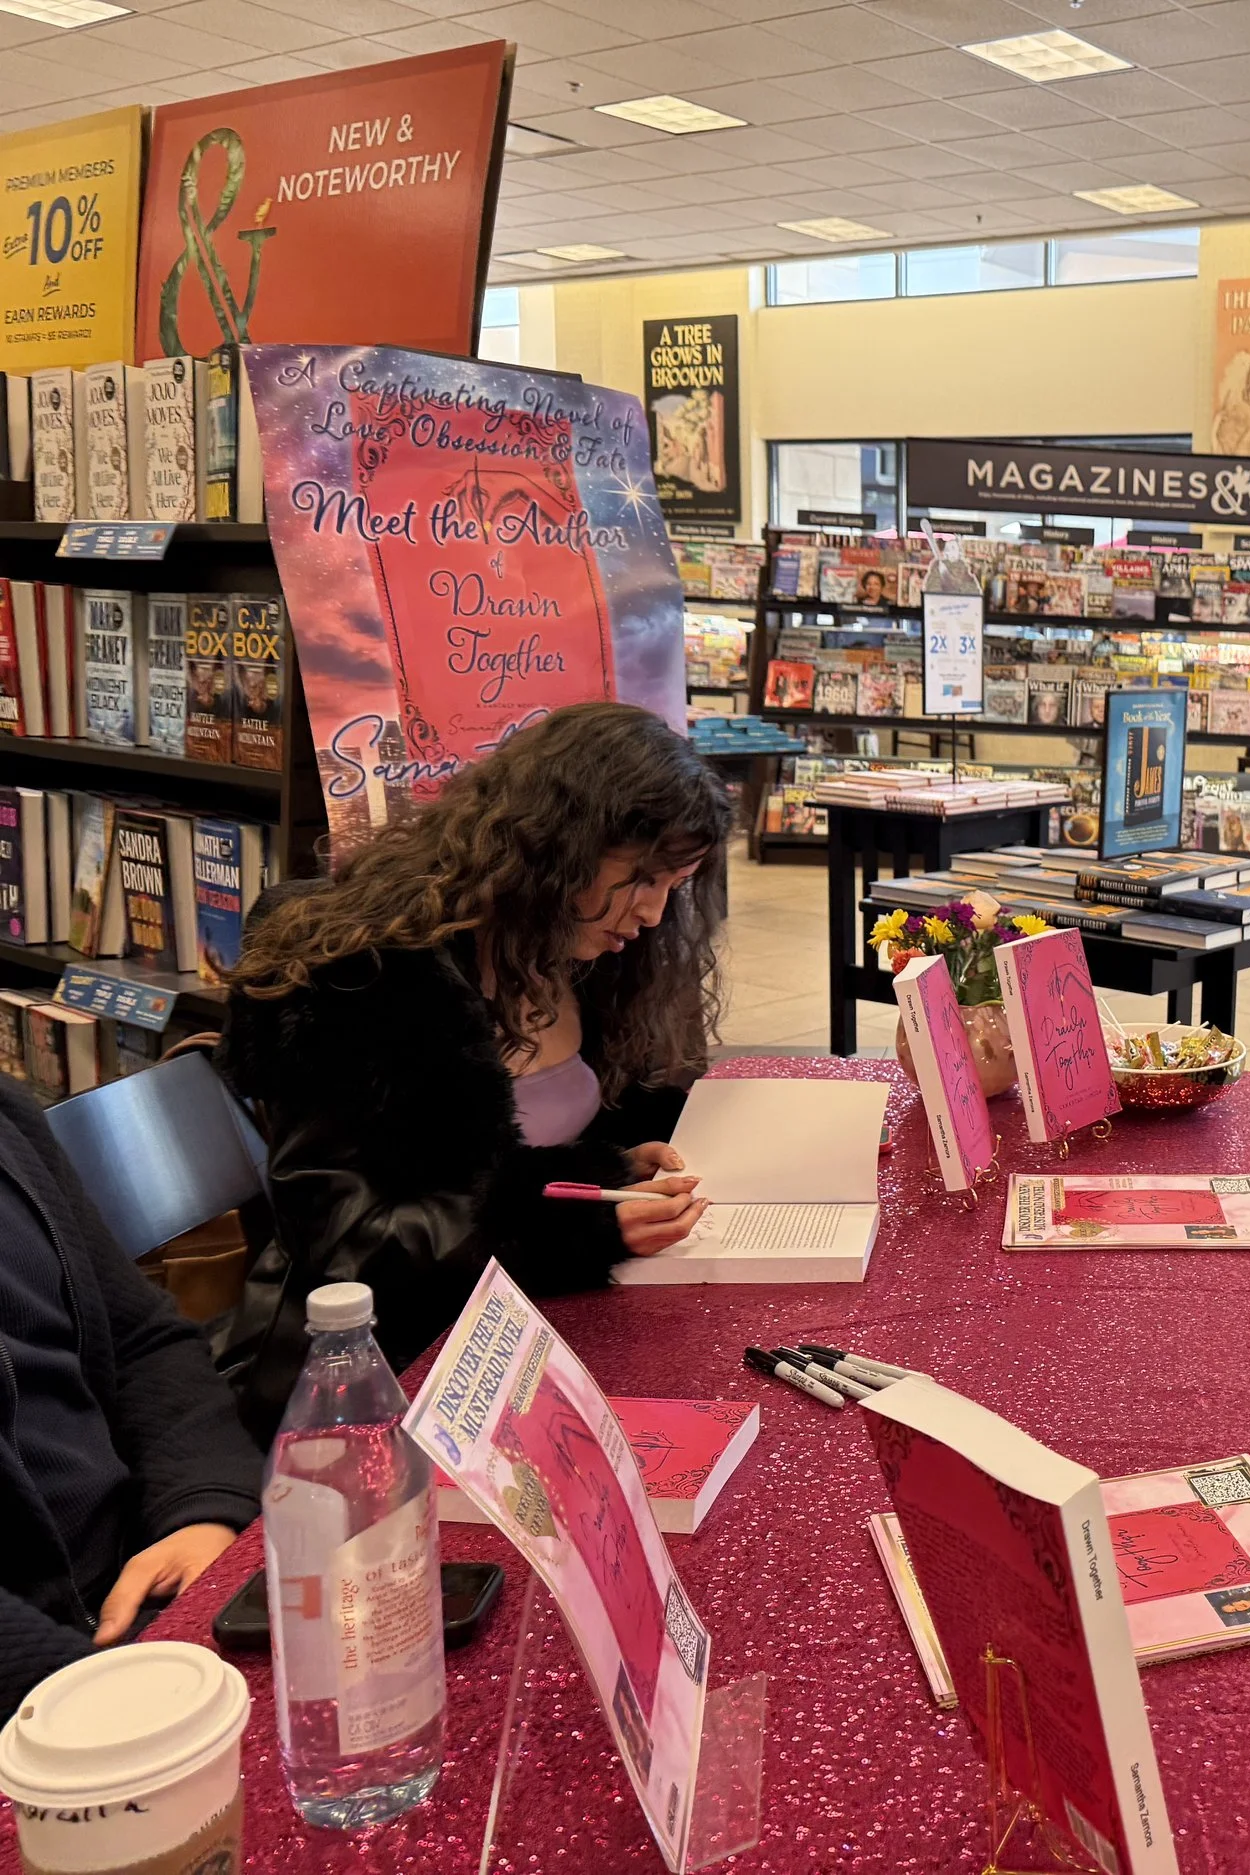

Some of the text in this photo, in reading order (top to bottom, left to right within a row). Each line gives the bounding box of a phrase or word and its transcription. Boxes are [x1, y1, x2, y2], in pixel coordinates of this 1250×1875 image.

[328, 112, 414, 153] NEW &
[59, 159, 115, 183] MEMBERS
[277, 150, 461, 204] NOTEWORTHY
[71, 238, 104, 261] OFF
[4, 303, 96, 325] EARN REWARDS
[660, 323, 713, 346] A TREE
[650, 343, 723, 369] GROWS IN
[150, 382, 176, 401] JOJO
[651, 365, 725, 389] BROOKLYN
[277, 356, 635, 444] A Captivating Novel of
[158, 447, 173, 463] We
[574, 437, 627, 471] Fate
[153, 469, 182, 486] All Live
[967, 459, 1208, 499] MAGAZINES
[156, 493, 178, 508] Here
[292, 481, 630, 551] Meet the Author
[489, 551, 505, 579] of
[1009, 560, 1044, 571] TANK
[429, 570, 563, 619] Drawn
[238, 607, 271, 630] C.J.
[185, 631, 228, 657] BOX
[233, 631, 281, 660] BOX
[930, 635, 948, 654] 2X
[959, 635, 976, 655] 3X
[446, 625, 566, 704] Together
[1123, 711, 1144, 724] Book
[1134, 726, 1162, 799] JAMES
[119, 829, 162, 865] SANDRA
[121, 861, 164, 897] BROWN
[906, 994, 919, 1033] Drawn Together
[1041, 1005, 1087, 1047] Drawn
[1045, 1031, 1096, 1091] Together
[936, 1115, 951, 1159] Samantha Zamora
[1018, 1205, 1030, 1232] DISCOVER
[436, 1291, 506, 1423] DISCOVER THE NEW
[495, 1317, 523, 1367] NOVEL
[1081, 1519, 1104, 1601] Drawn Together
[340, 1579, 360, 1670] the heritage
[1130, 1762, 1154, 1848] Samantha Zamora
